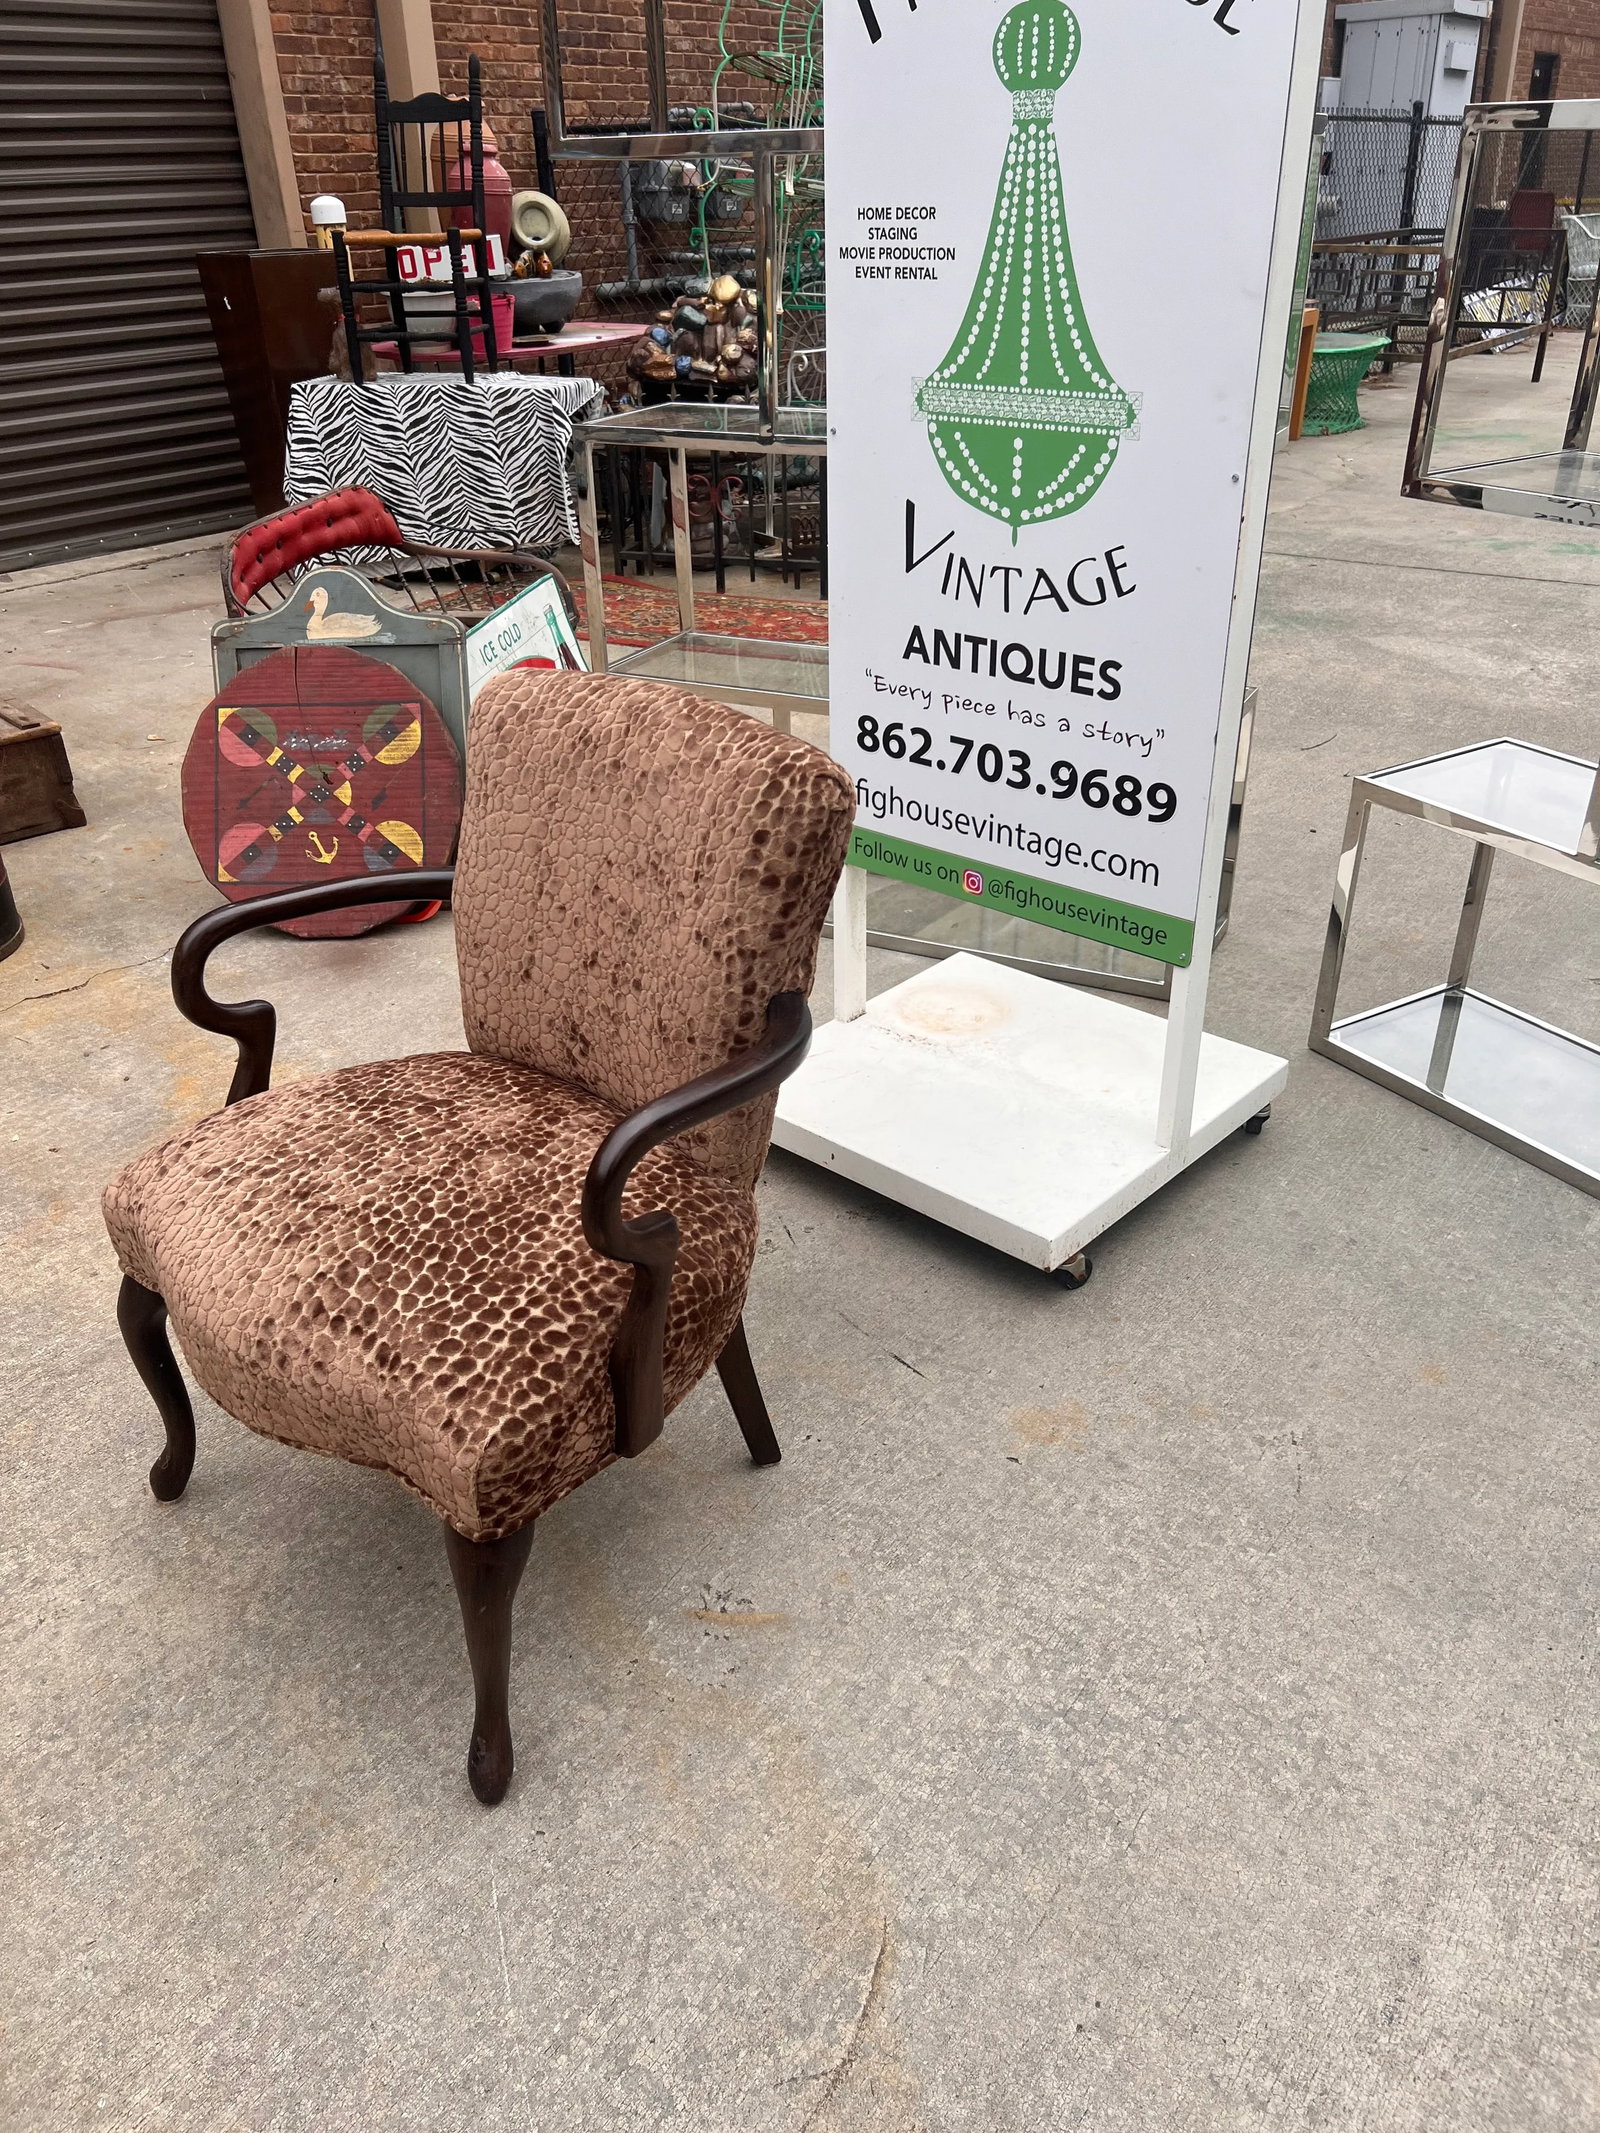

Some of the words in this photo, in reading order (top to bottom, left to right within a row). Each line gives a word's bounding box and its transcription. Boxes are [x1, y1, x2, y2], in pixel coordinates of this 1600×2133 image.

[857, 207, 892, 221] HOME
[895, 206, 937, 220] DECOR
[868, 227, 918, 240] STAGING
[839, 246, 876, 260] MOVIE
[878, 247, 956, 261] PRODUCTION
[855, 266, 891, 279] EVENT
[894, 266, 938, 280] RENTAL
[905, 498, 1137, 616] VINTAGE
[479, 640, 498, 667] ICE
[497, 622, 522, 652] COLD
[902, 624, 1123, 701] ANTIQUES
[942, 693, 996, 716] piece
[1007, 700, 1046, 728] has
[1058, 717, 1071, 733] a
[856, 714, 1178, 824] 862.703.9689
[856, 777, 1161, 887] fighousevintage.com
[853, 836, 909, 868] Follow
[913, 858, 932, 876] us
[937, 865, 959, 884] on
[988, 878, 1169, 946] @fighousevintage
